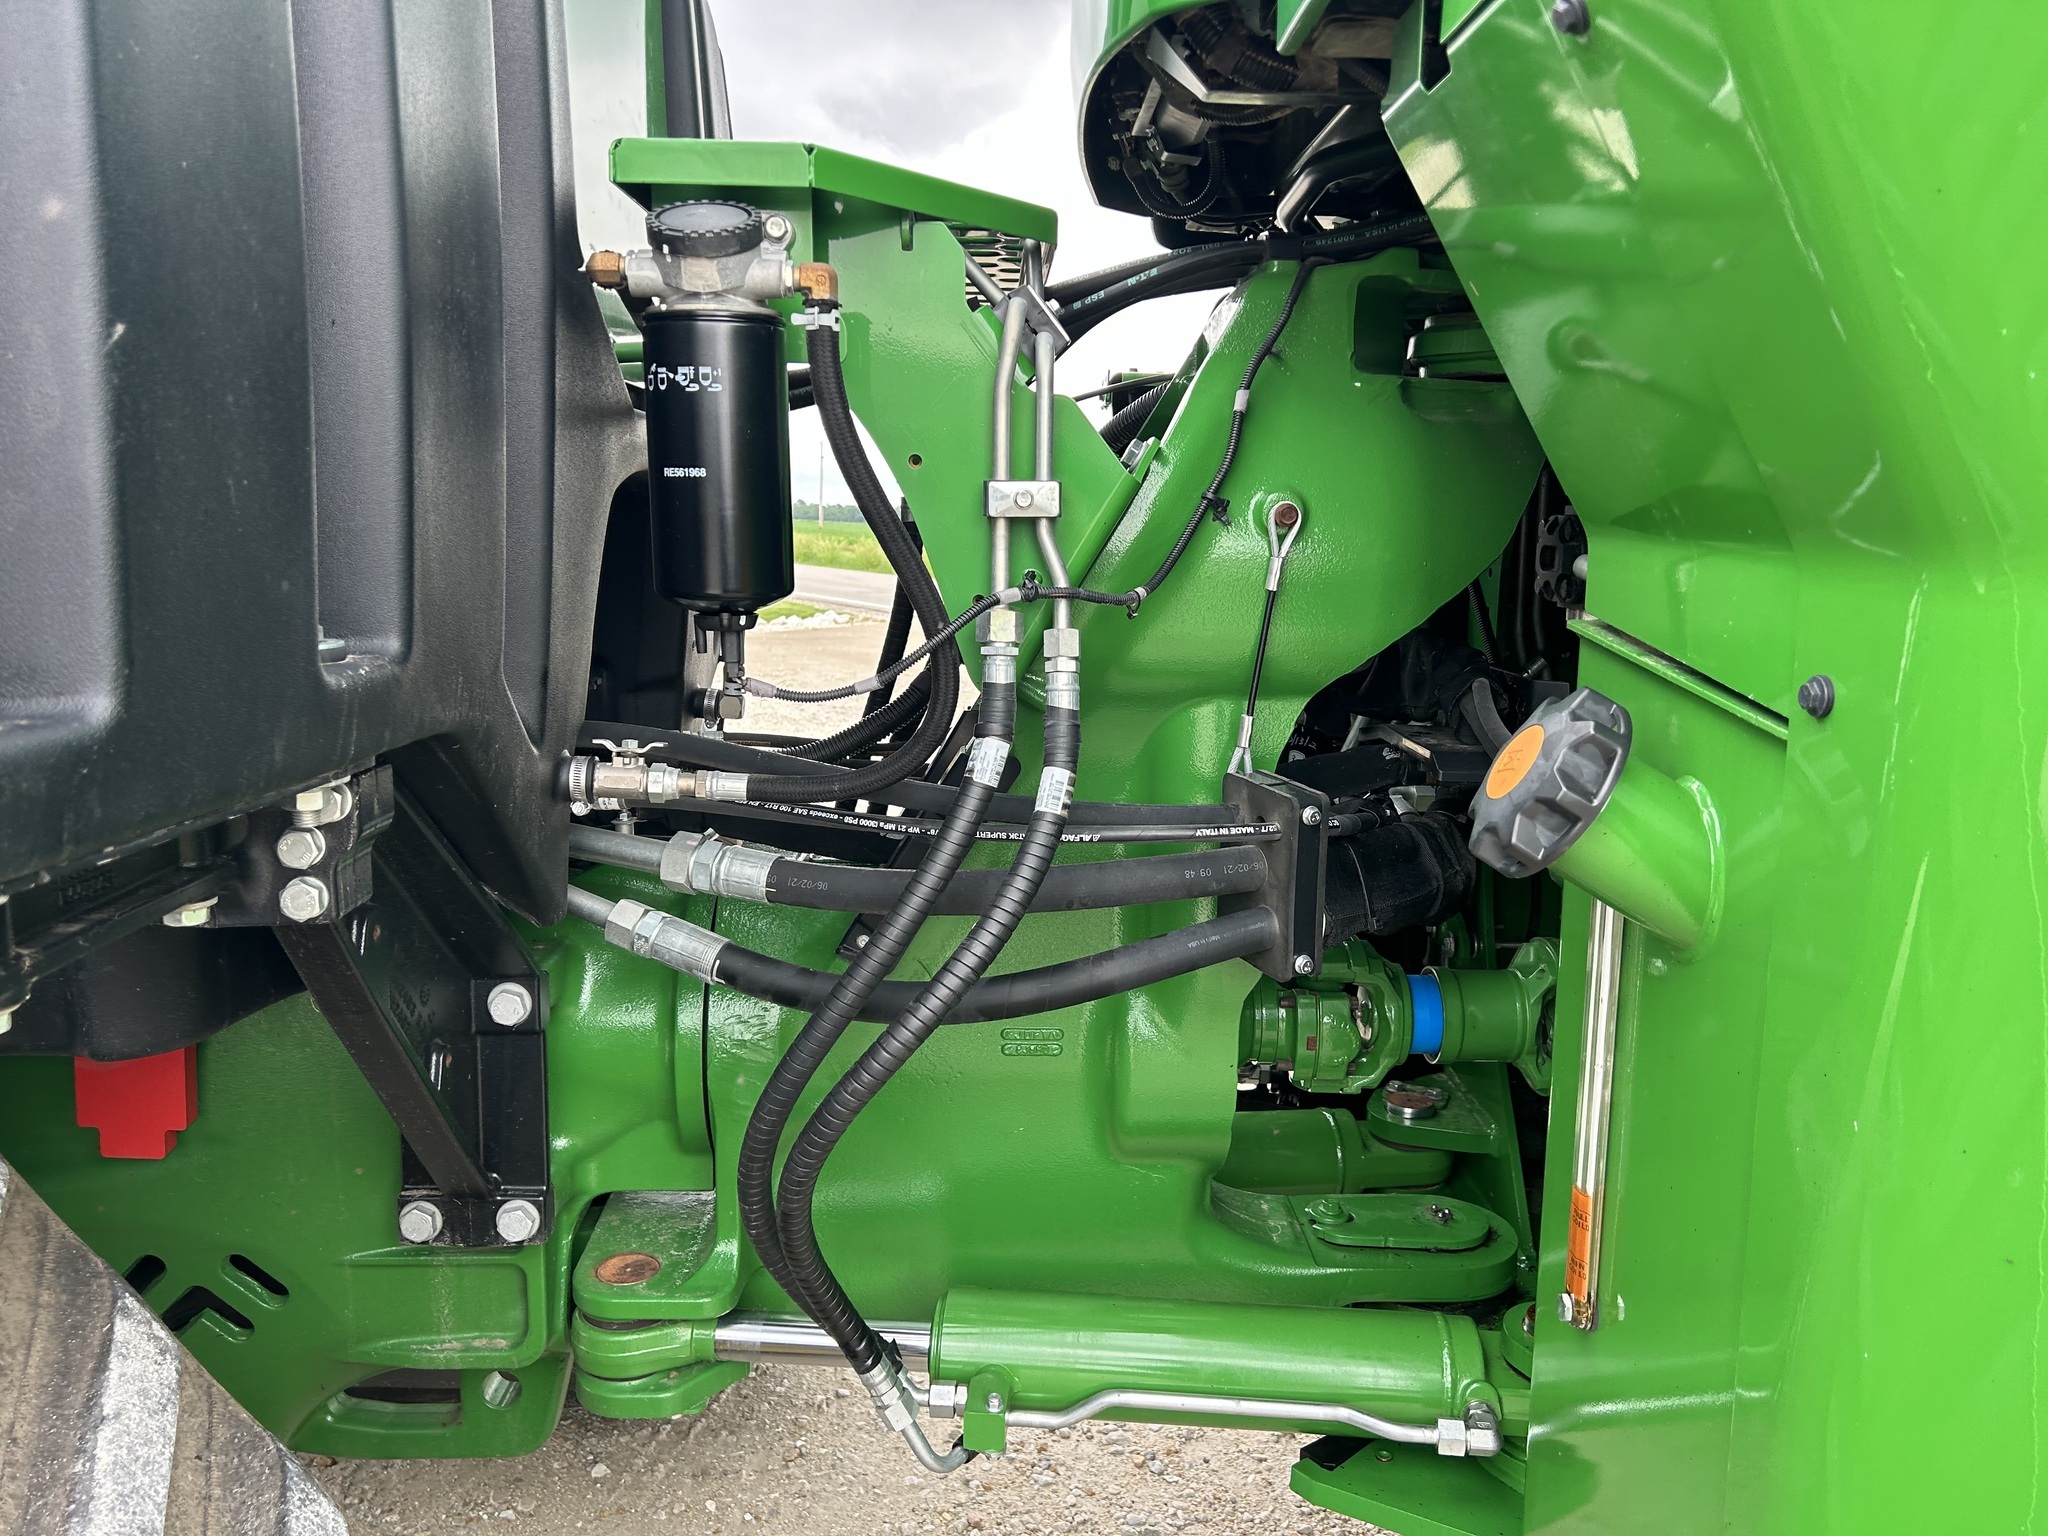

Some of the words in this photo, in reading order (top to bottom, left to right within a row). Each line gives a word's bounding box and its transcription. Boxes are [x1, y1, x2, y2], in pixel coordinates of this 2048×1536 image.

[663, 467, 707, 478] RE561968
[780, 804, 792, 812] 100
[792, 807, 809, 816] SAE
[809, 809, 839, 820] exceeds
[879, 821, 896, 831] MPa
[897, 825, 907, 833] 21
[907, 826, 921, 834] WP
[1230, 825, 1255, 834] MADE
[974, 831, 1008, 840] SUPERT
[1195, 827, 1219, 837] ITALY
[1219, 827, 1229, 835] IN
[1223, 861, 1264, 875] 06/02/21
[787, 877, 828, 891] 06/02/21
